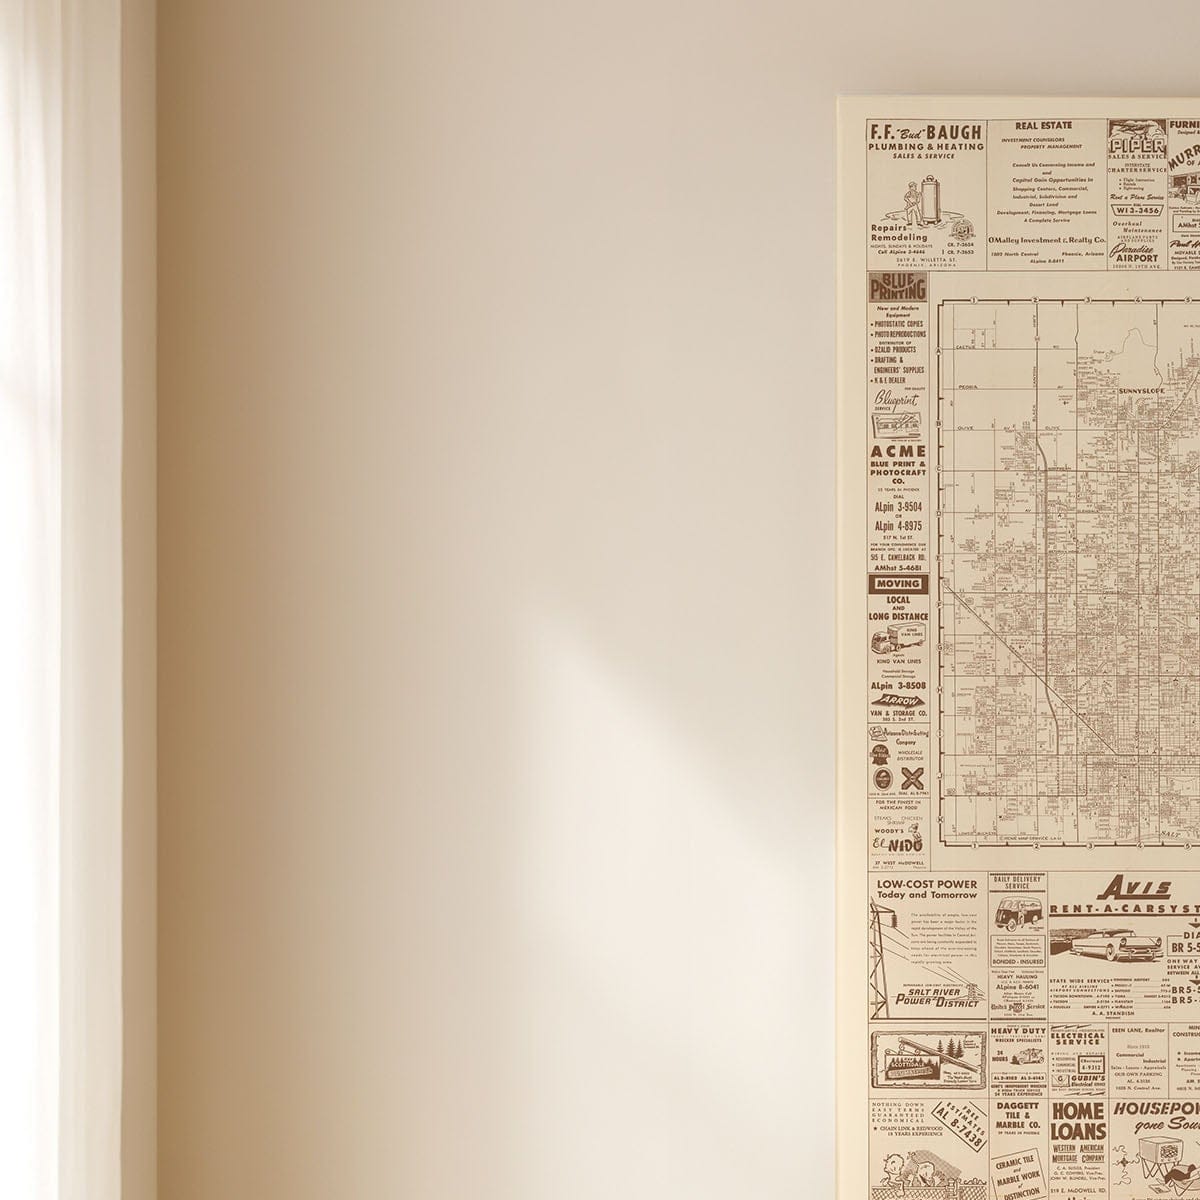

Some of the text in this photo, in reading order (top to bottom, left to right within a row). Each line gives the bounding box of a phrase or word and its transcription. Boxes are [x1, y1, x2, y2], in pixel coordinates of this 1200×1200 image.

[1015, 121, 1073, 130] REAL ESTATE
[926, 124, 982, 140] BAUGH
[1110, 139, 1167, 154] PIPER
[871, 224, 907, 233] Repairs
[871, 234, 928, 243] Remodeling
[1020, 236, 1061, 244] Investment
[1068, 236, 1093, 245] Realty
[1094, 236, 1107, 244] Co.
[1116, 254, 1158, 262] AIRPORT
[882, 273, 915, 288] BLUE
[871, 279, 926, 300] PRINTING
[874, 389, 919, 413] Blueprint
[870, 445, 926, 457] ACME
[874, 501, 922, 513] ALpin 3-9504
[874, 520, 923, 532] ALpin 4-8975
[877, 580, 920, 588] MOVING
[887, 596, 910, 604] LOCAL
[869, 613, 890, 621] LONG
[871, 682, 926, 690] ALpin 3-8508
[877, 880, 978, 889] LOW-COST POWER
[877, 890, 978, 900] Today and Tomorrow
[1171, 942, 1185, 953] BR
[908, 988, 961, 996] SALT RIVER
[895, 993, 979, 1008] POWER DISTRICT
[1053, 1103, 1104, 1120] HOME
[936, 1107, 983, 1147] AL 8-7438
[996, 1121, 1041, 1129] MARBLE CO.
[1135, 1121, 1165, 1135] gone
[1051, 1122, 1107, 1141] LOANS
[997, 1170, 1040, 1187] MARBLE WORK
